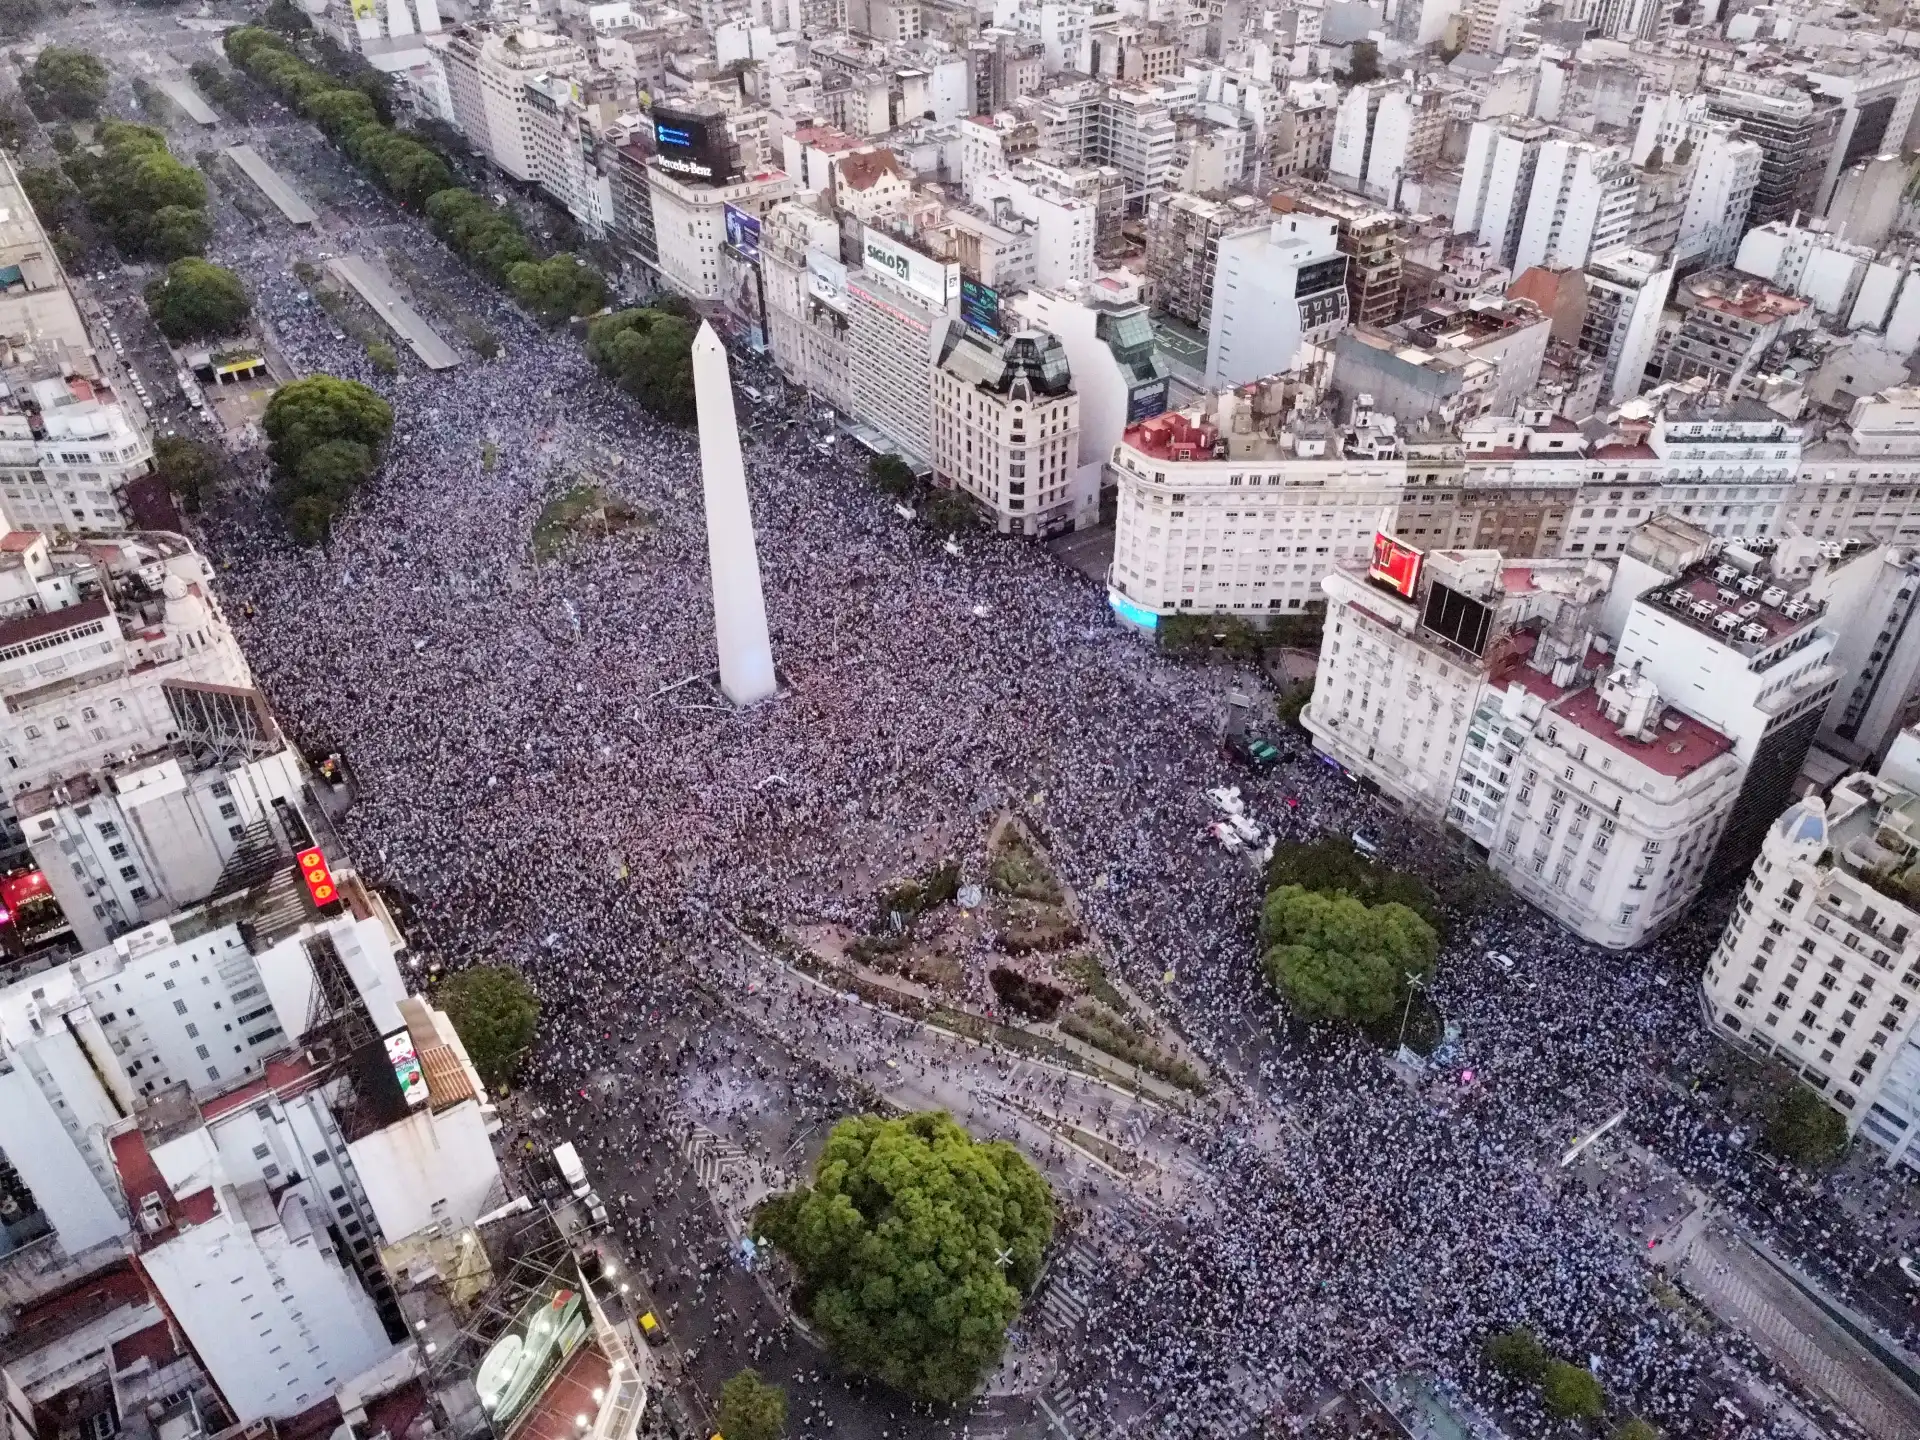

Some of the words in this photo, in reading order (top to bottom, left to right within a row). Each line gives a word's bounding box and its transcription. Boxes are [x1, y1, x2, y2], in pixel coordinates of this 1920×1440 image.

[658, 154, 712, 176] Mercedes-Benz
[867, 244, 895, 269] SIGLO
[897, 259, 908, 281] 21
